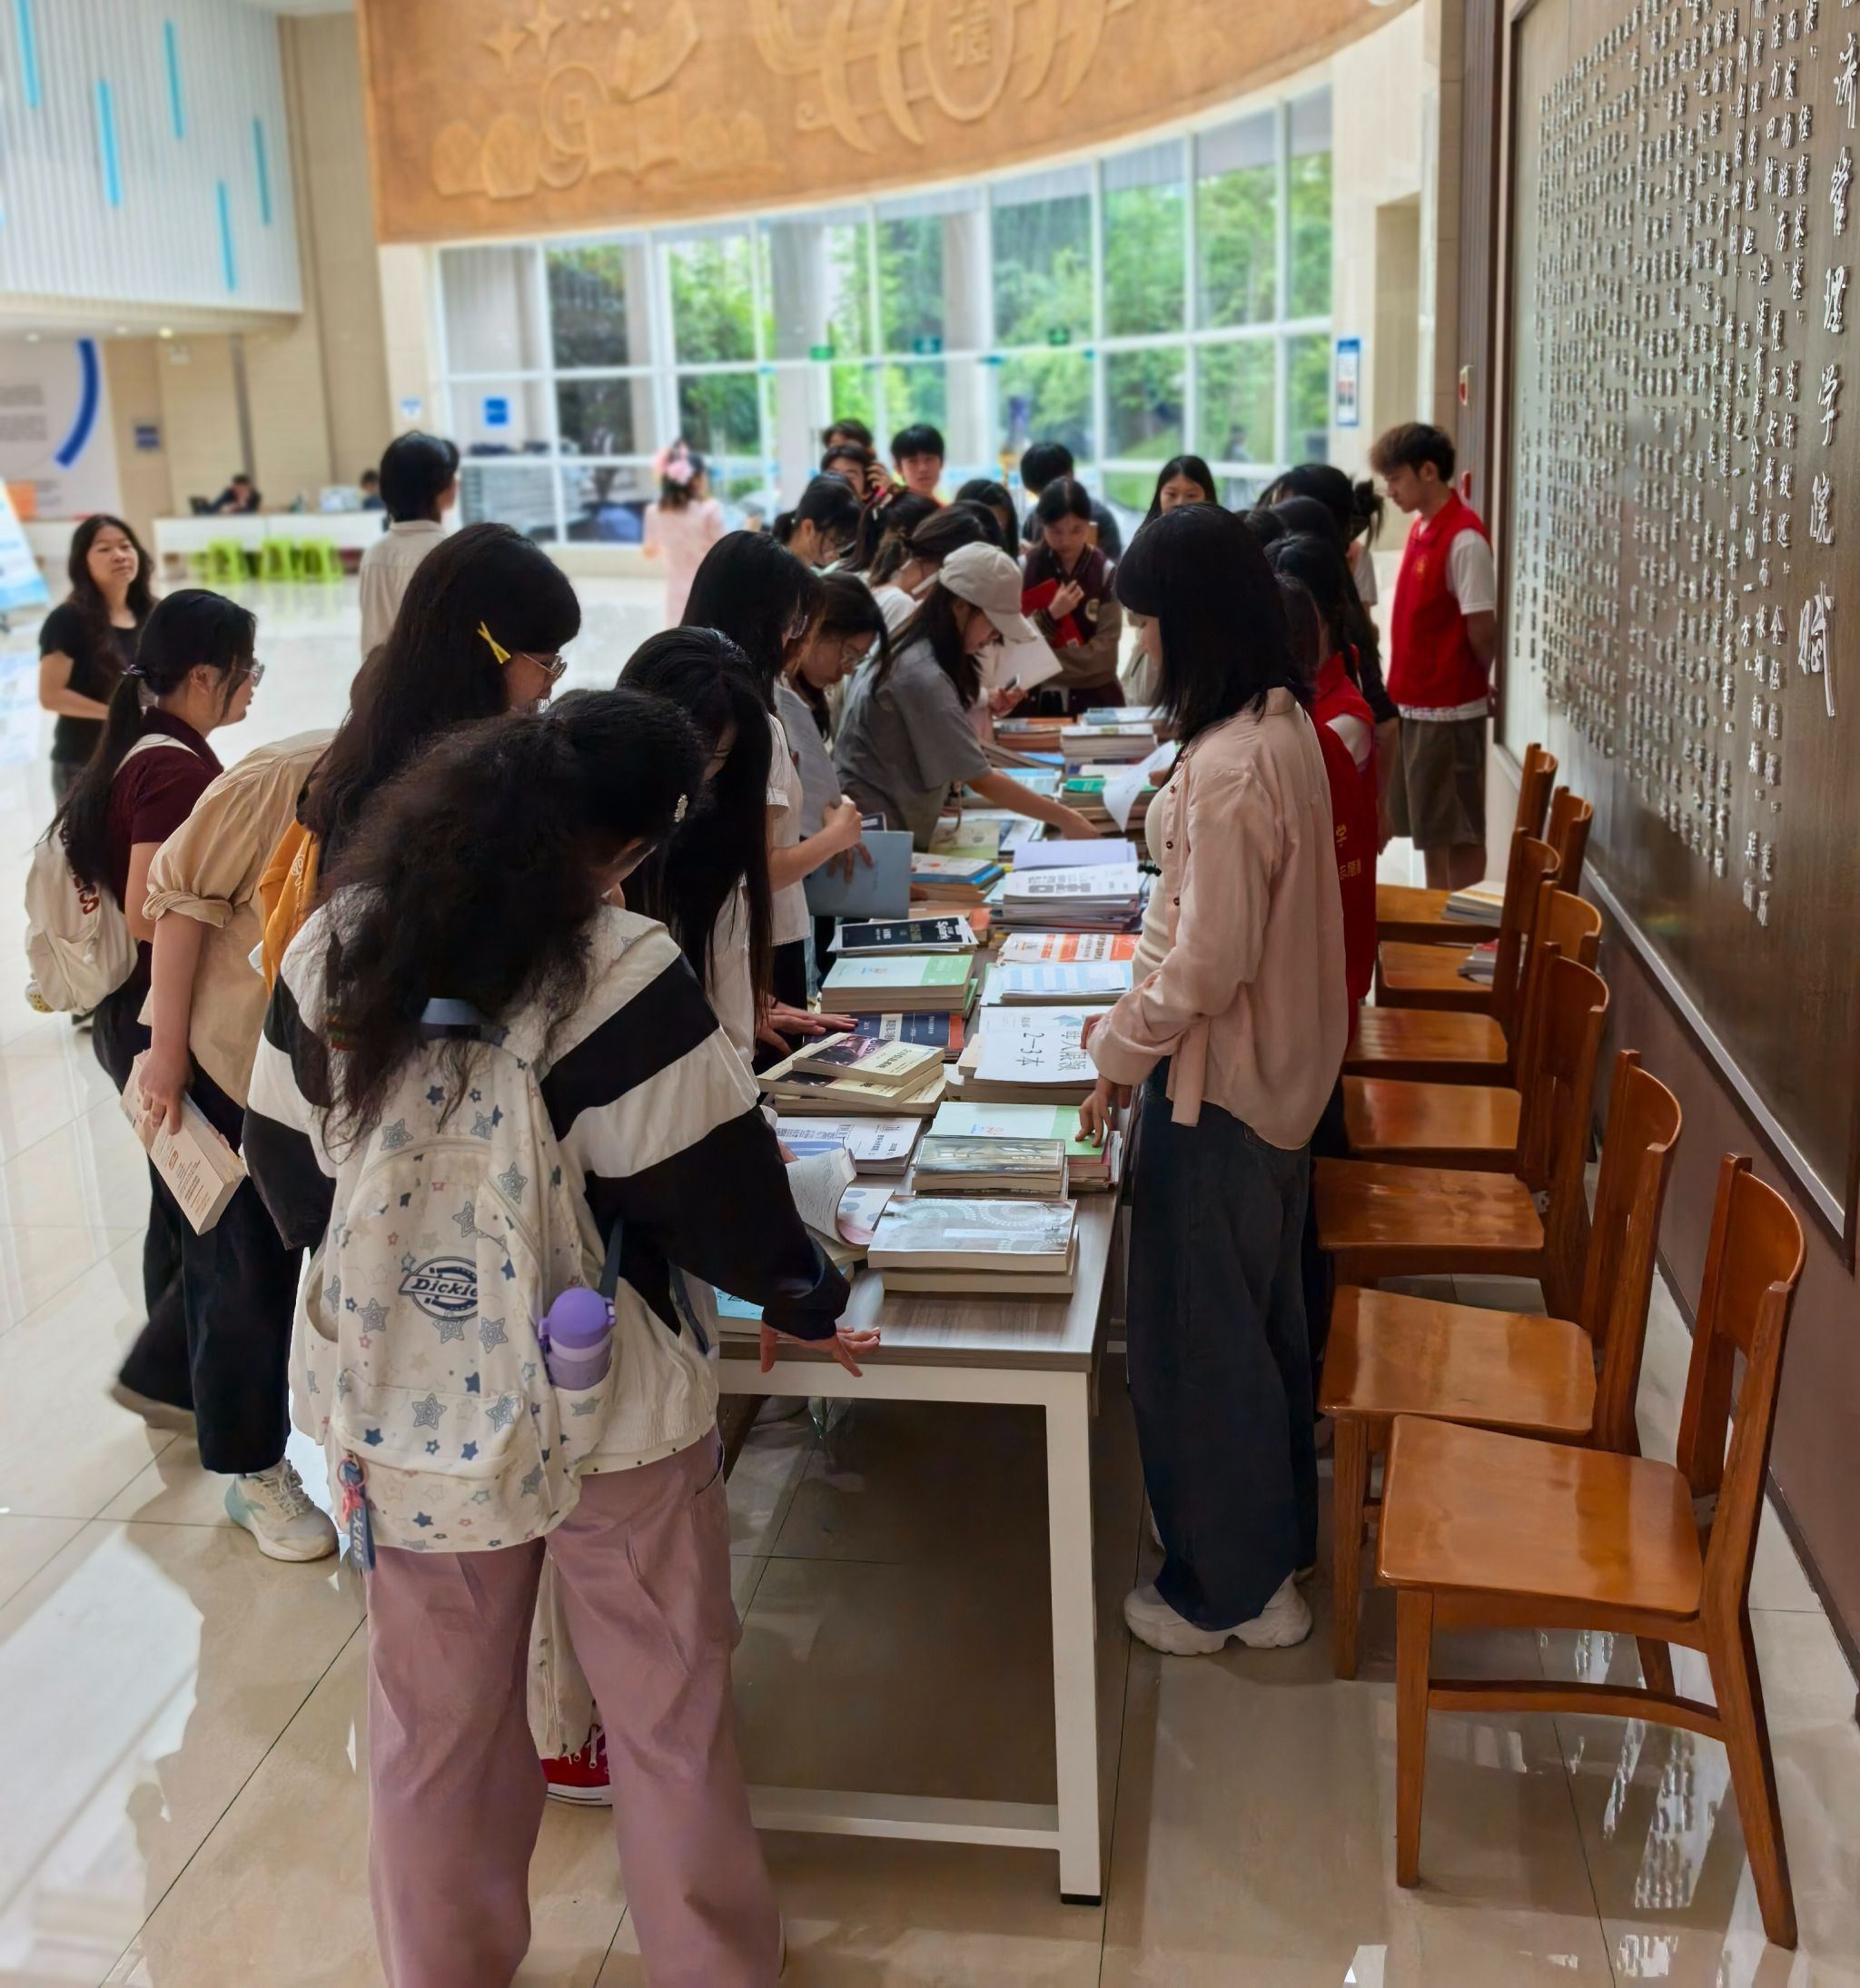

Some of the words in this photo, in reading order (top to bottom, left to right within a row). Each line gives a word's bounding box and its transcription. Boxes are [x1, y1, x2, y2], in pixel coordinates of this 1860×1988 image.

[1797, 0, 1859, 718] 济管理学院赋
[935, 920, 951, 941] Spark
[411, 1278, 478, 1298] Dickie
